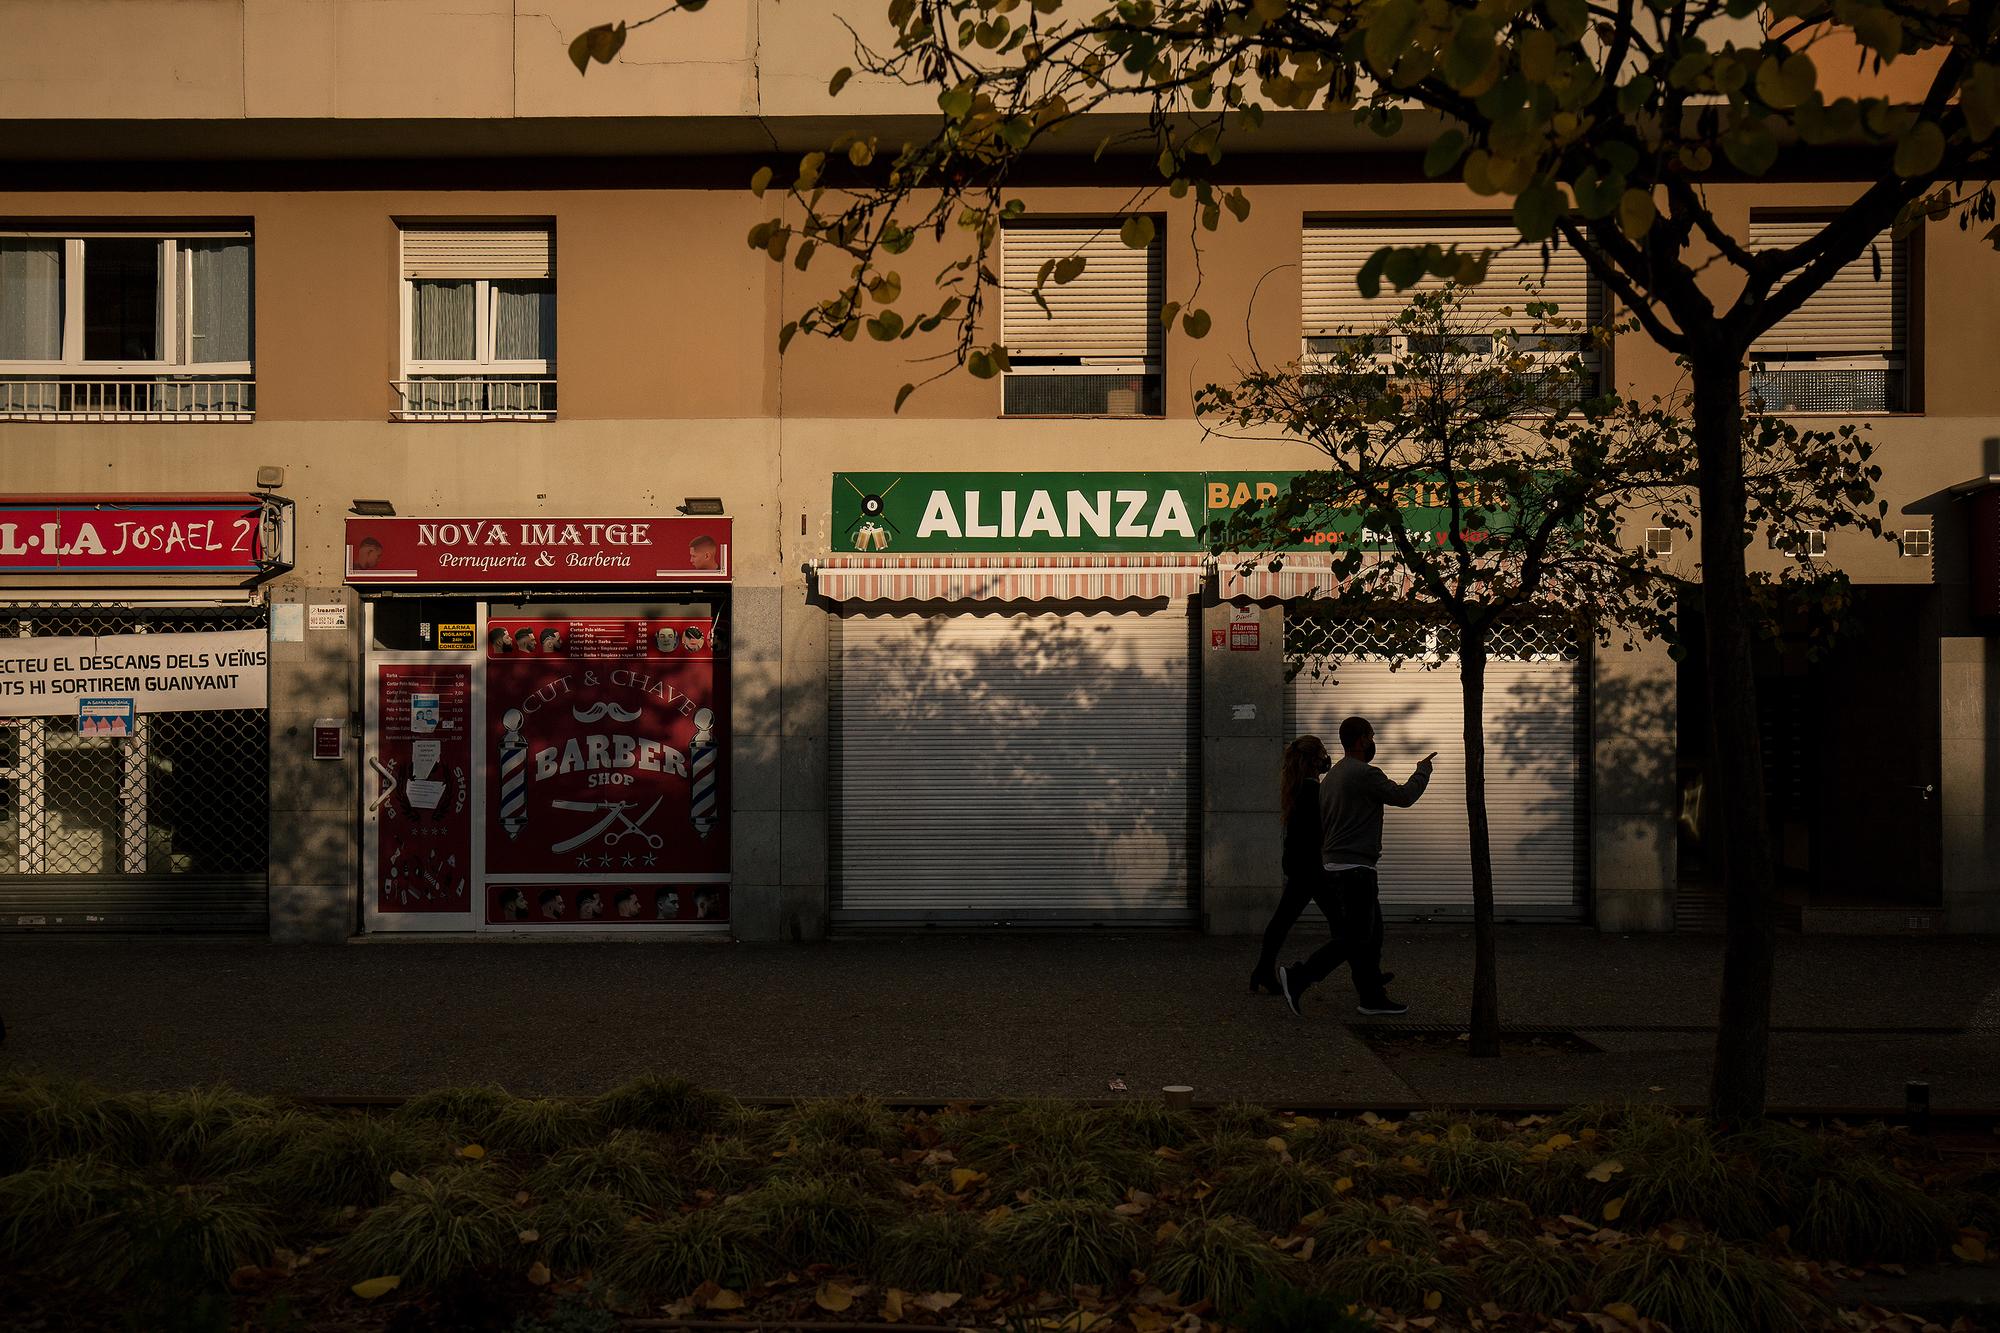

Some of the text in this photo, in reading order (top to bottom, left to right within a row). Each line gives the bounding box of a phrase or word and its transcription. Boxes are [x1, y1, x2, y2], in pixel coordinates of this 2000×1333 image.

[1208, 481, 1279, 509] BAR
[916, 489, 1195, 538] ALIANZA
[231, 519, 250, 552] 2
[417, 520, 653, 546] NOVA IMATGE
[1290, 527, 1346, 547] apas
[439, 551, 631, 572] Perruqueria & Barberia
[1232, 623, 1258, 631] Alarma
[53, 656, 75, 672] EL
[80, 654, 161, 671] DESCANS
[166, 653, 209, 669] DELS
[214, 649, 267, 667] VEÏNS
[0, 674, 239, 695] TS HI SORTIREM GUANYANT
[522, 669, 698, 718] CUT & CHAVE
[535, 734, 689, 782] BARBER
[588, 772, 635, 789] SHOP
